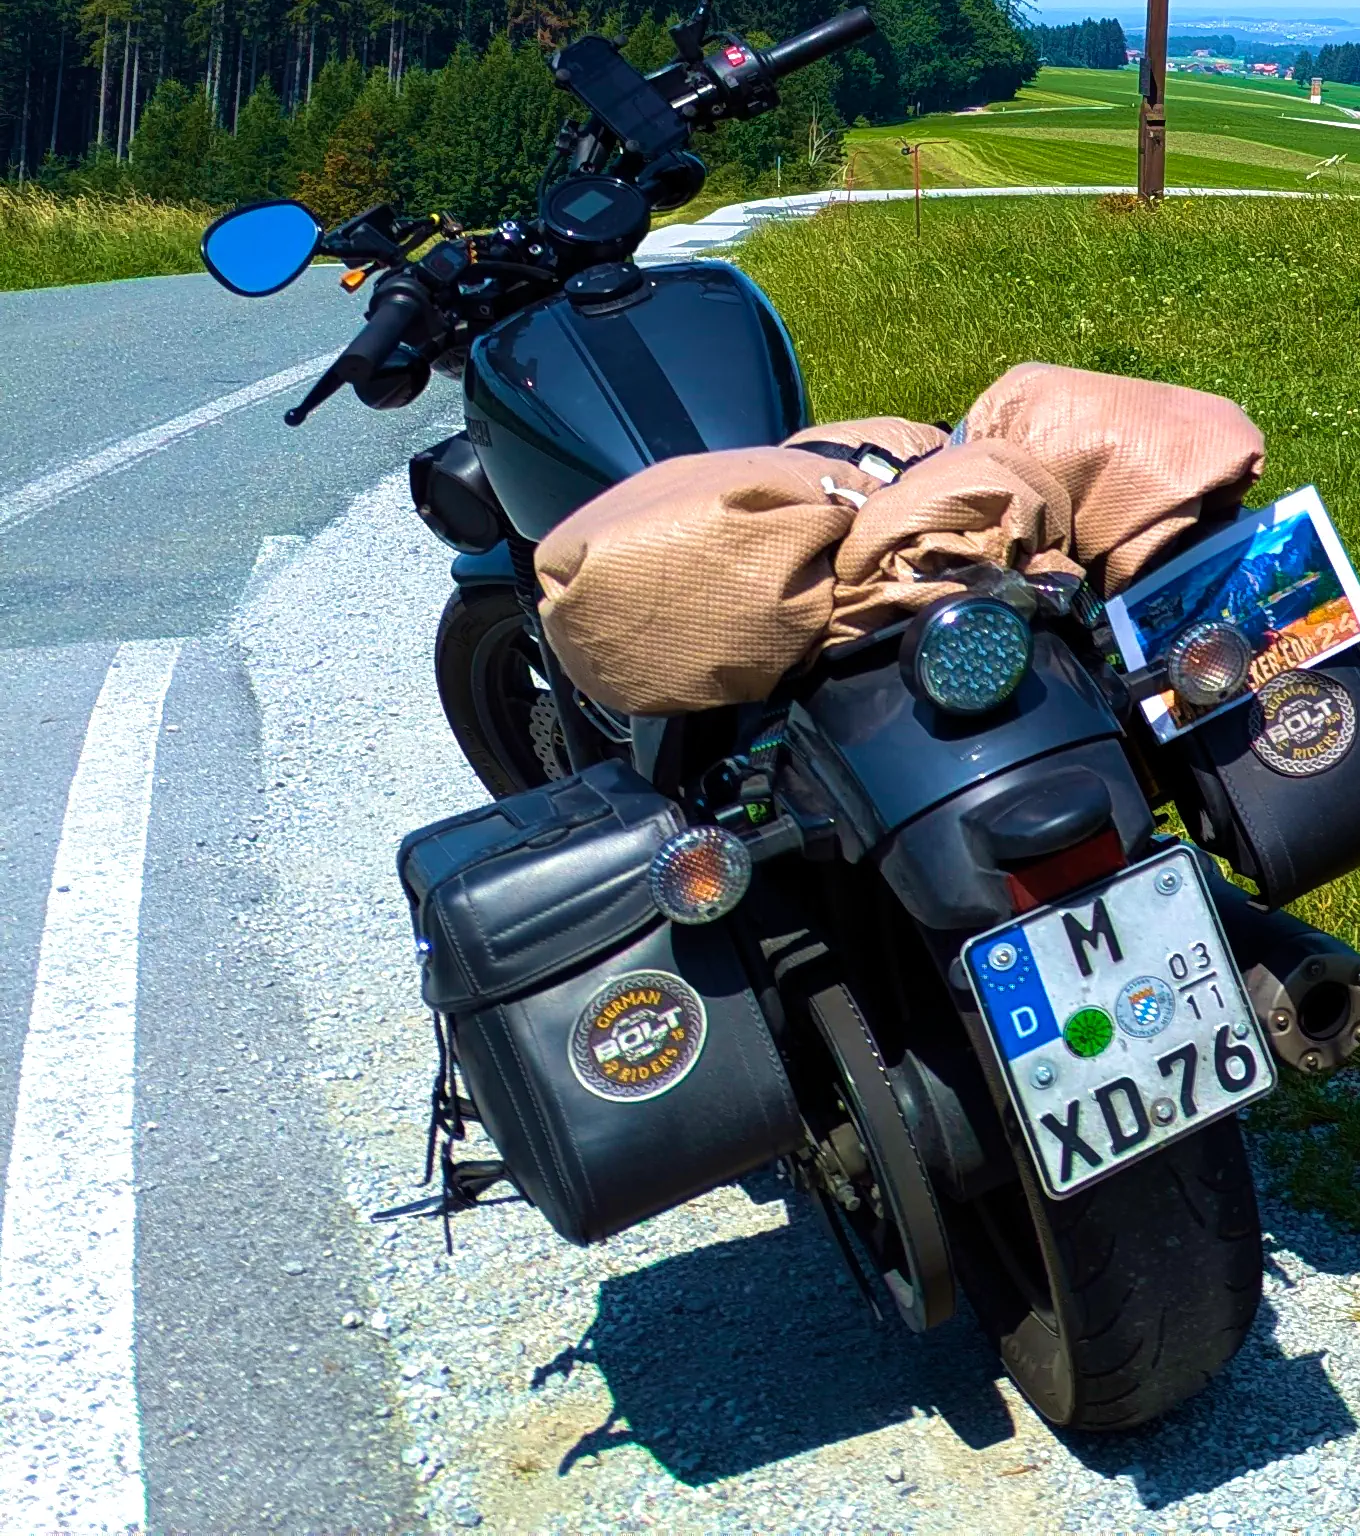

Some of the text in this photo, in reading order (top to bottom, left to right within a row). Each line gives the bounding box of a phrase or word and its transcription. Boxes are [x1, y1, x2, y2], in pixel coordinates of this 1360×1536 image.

[1315, 613, 1360, 651] 24
[1264, 684, 1320, 720] GERMAN
[1266, 698, 1332, 744] BOLT
[1292, 729, 1339, 759] RIDERS
[1061, 898, 1123, 977] M
[1169, 942, 1212, 979] 03
[596, 990, 662, 1028] GERMAN
[1186, 984, 1225, 1020] 11
[592, 1006, 682, 1064] BOLT
[1010, 1005, 1038, 1039] D
[618, 1047, 679, 1082] RIDERS
[1040, 1024, 1257, 1182] XD 76
